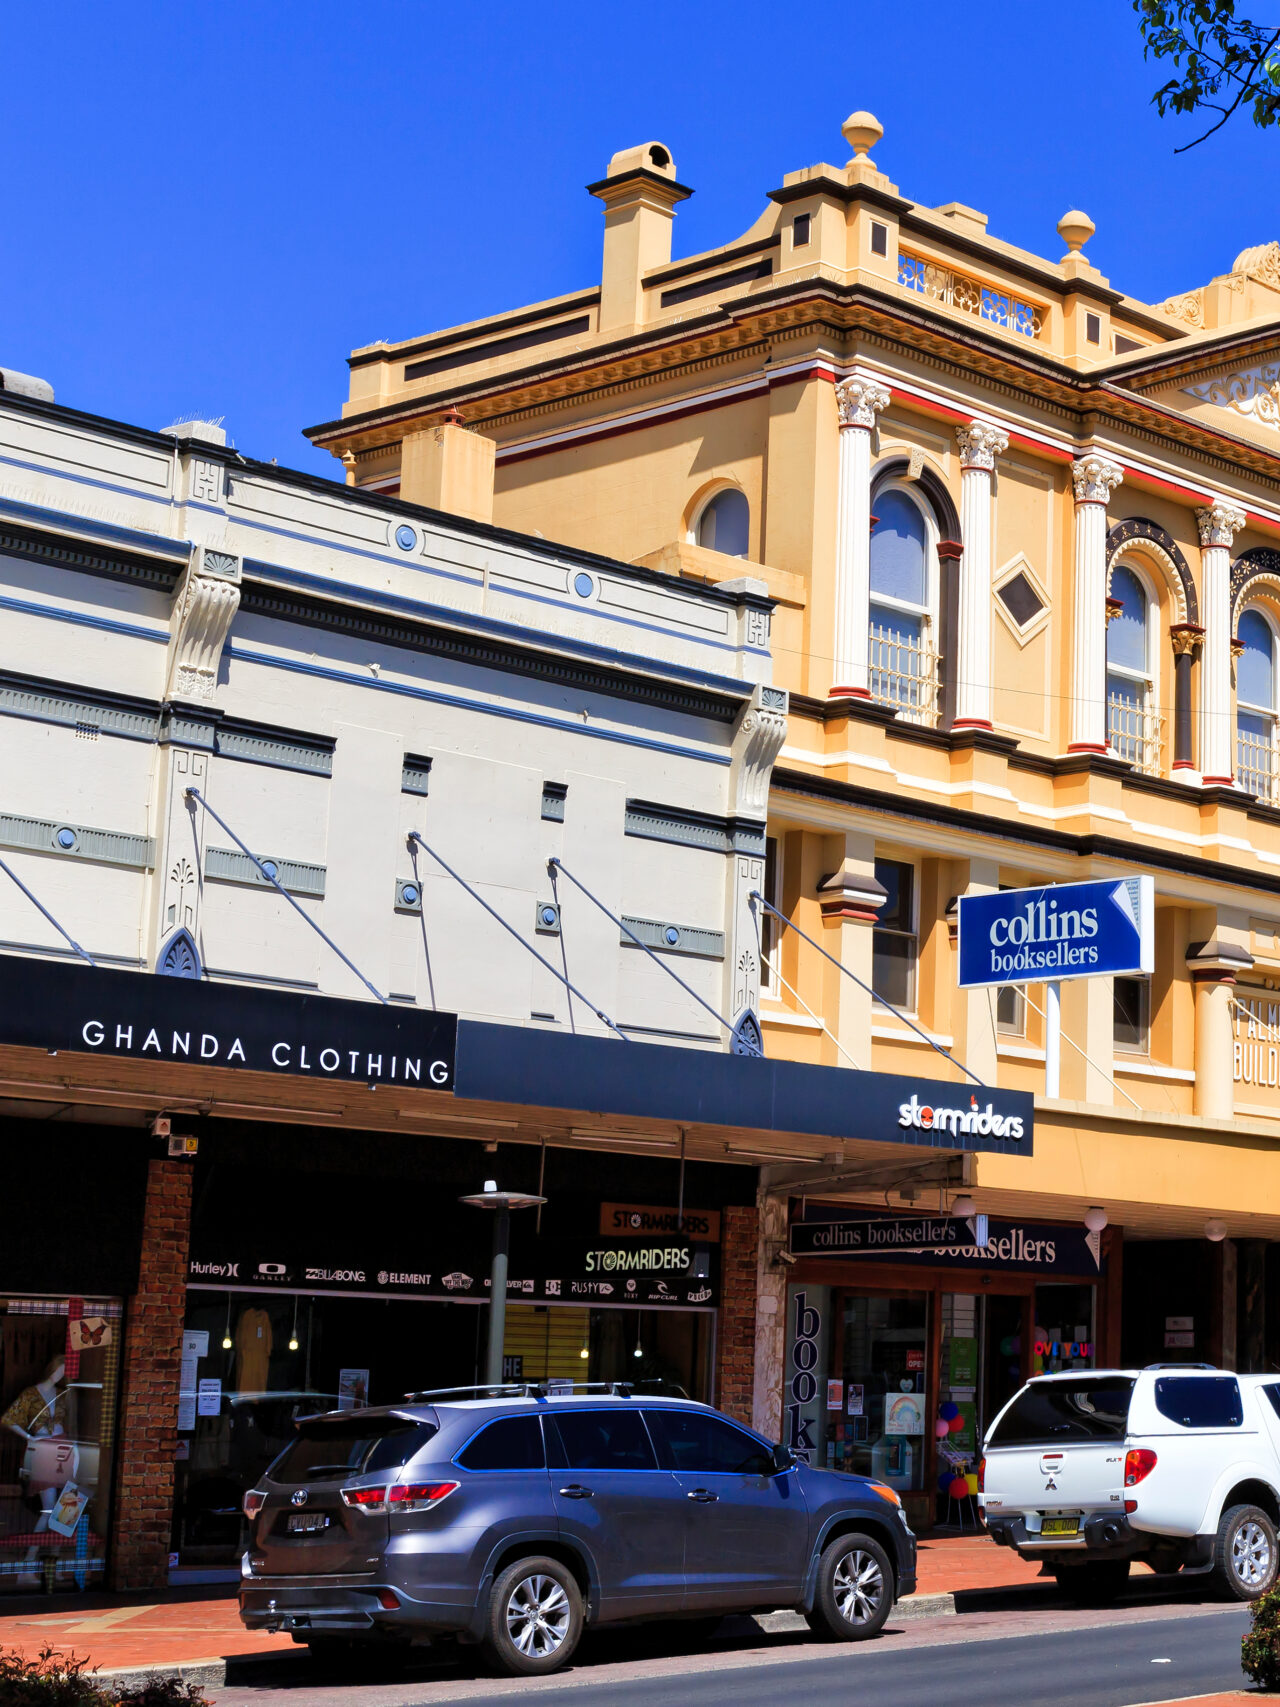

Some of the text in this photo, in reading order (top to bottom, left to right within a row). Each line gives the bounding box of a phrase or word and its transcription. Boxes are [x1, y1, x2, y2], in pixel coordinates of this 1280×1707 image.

[989, 900, 1099, 947] collins
[991, 942, 1099, 972] booksellers
[82, 1021, 449, 1084] GHANDA CLOTHING
[613, 1211, 709, 1233] STORMRIDERS
[812, 1220, 956, 1247] collins booksellers
[934, 1229, 1056, 1264] sellers
[191, 1261, 226, 1277] Hurley
[585, 1248, 690, 1271] STORMRIDERS
[390, 1272, 431, 1286] ELEMENT
[1034, 1341, 1059, 1357] OVE
[503, 1360, 521, 1376] HE
[908, 1360, 925, 1368] OPE
